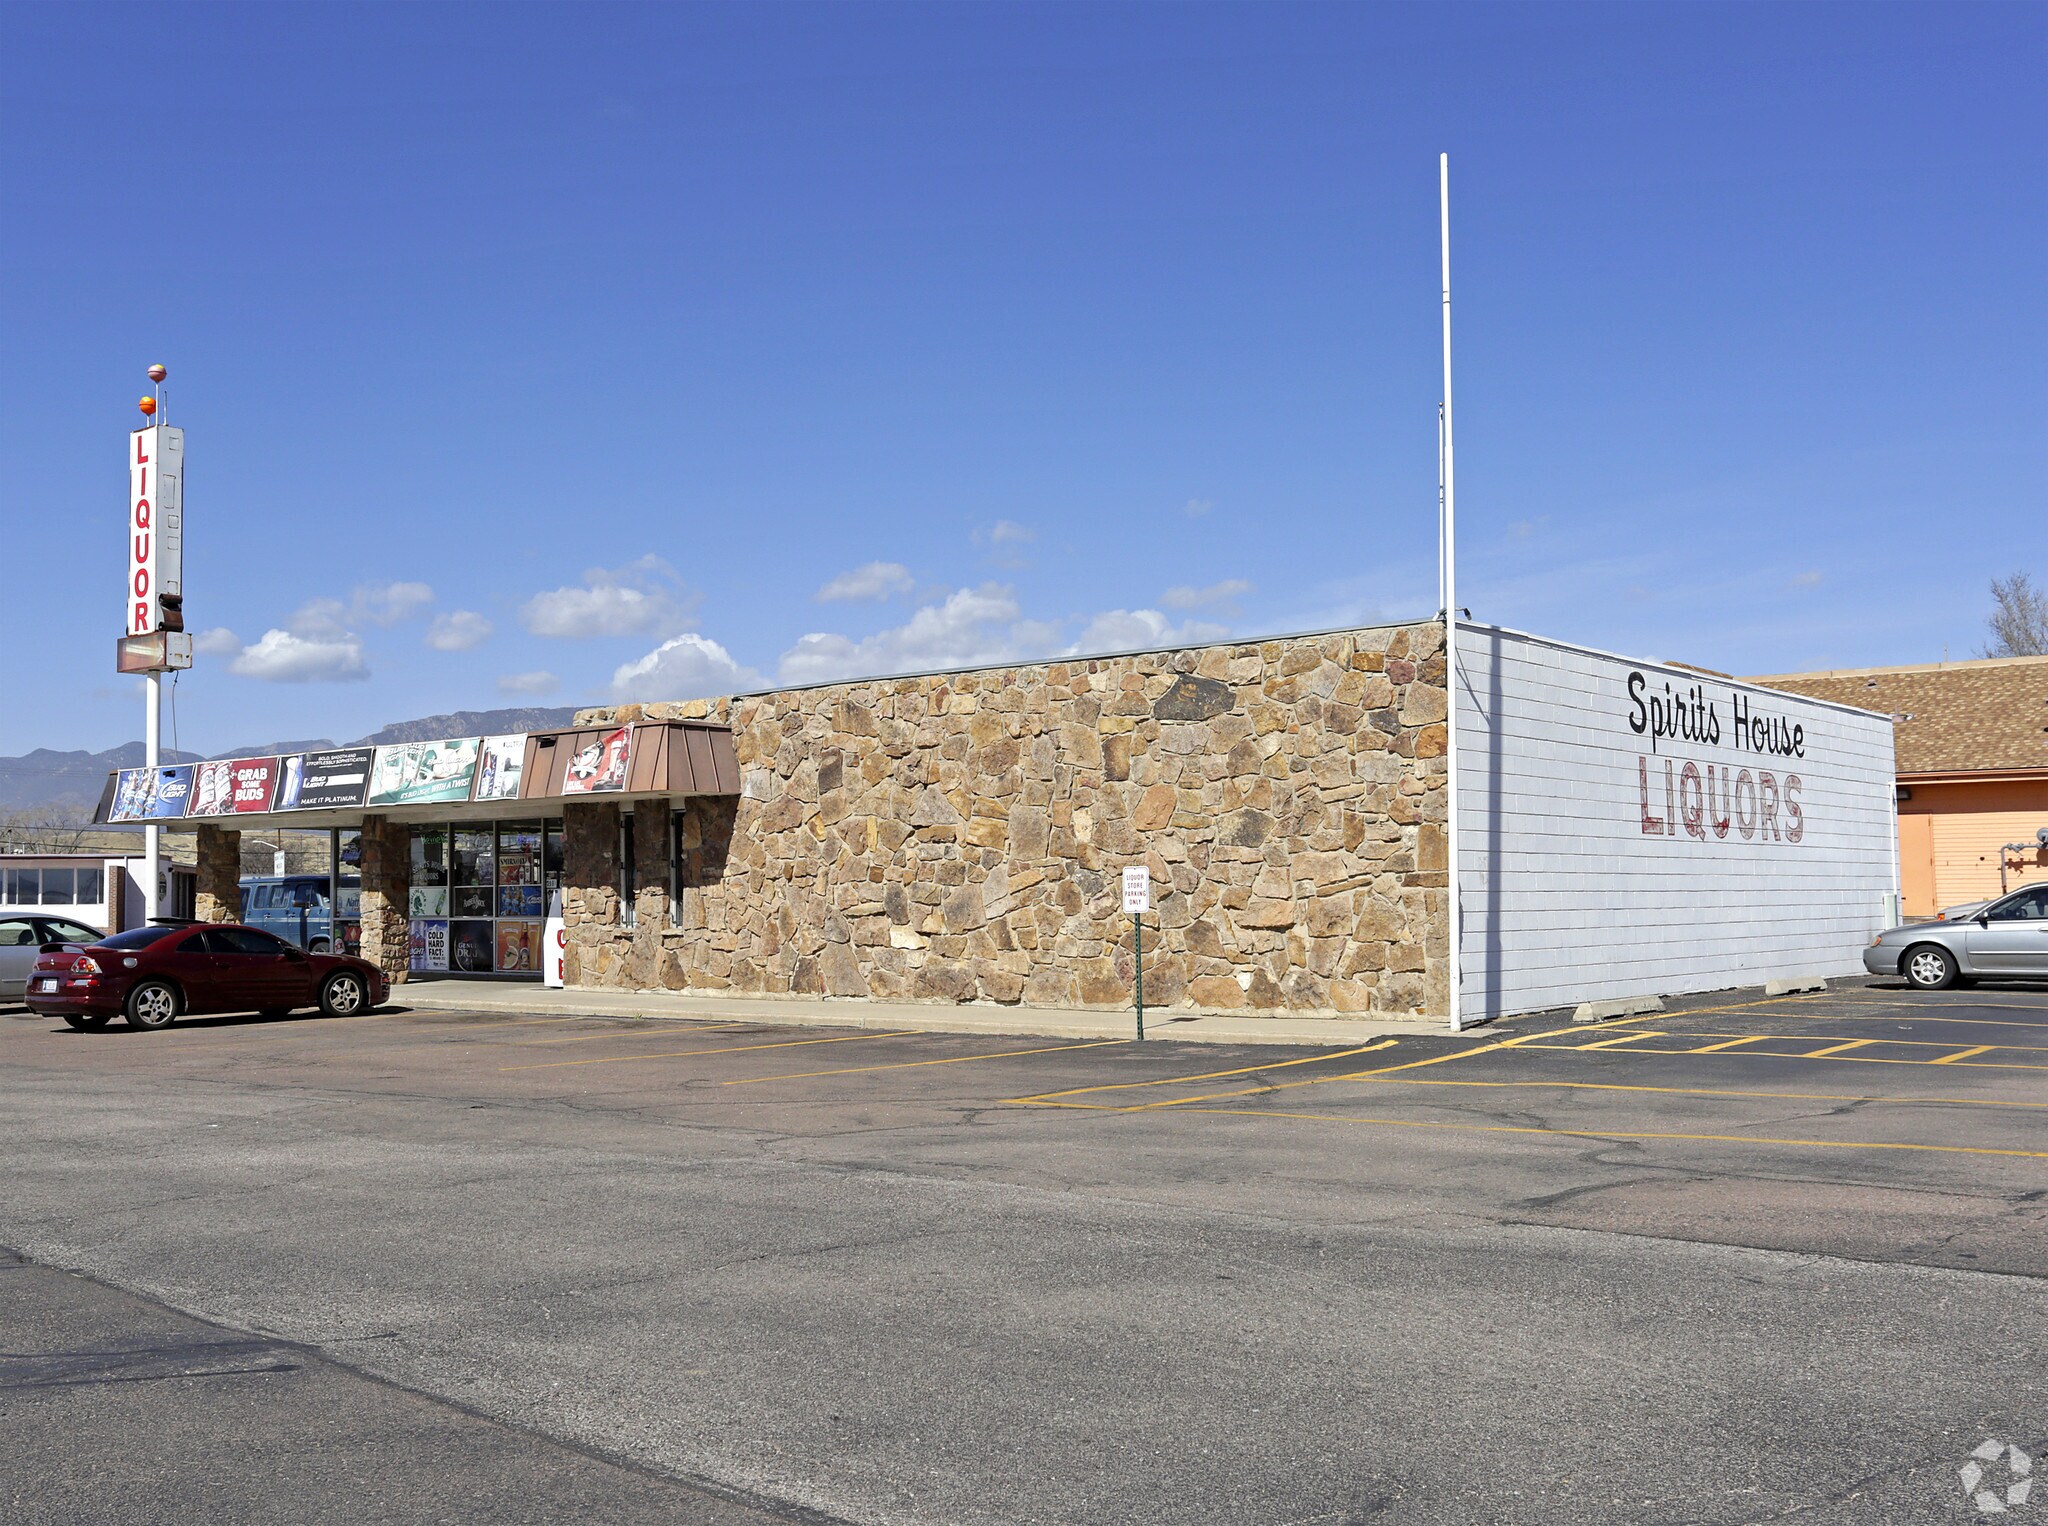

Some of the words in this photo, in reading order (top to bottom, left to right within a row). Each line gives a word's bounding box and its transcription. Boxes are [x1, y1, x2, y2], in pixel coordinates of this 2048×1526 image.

[134, 435, 150, 632] LIQUOR
[1628, 671, 1720, 754] Spirits
[1733, 693, 1805, 758] House
[237, 768, 268, 781] GRAB
[241, 780, 261, 788] SOME
[431, 783, 446, 792] WITH
[451, 777, 471, 788] TWIST
[163, 790, 187, 798] LIGHT
[235, 788, 264, 801] BUDS
[1639, 756, 1804, 843] LIQUORS
[428, 931, 444, 940] COLD
[428, 940, 444, 948] HARD
[428, 948, 444, 957] FACT:
